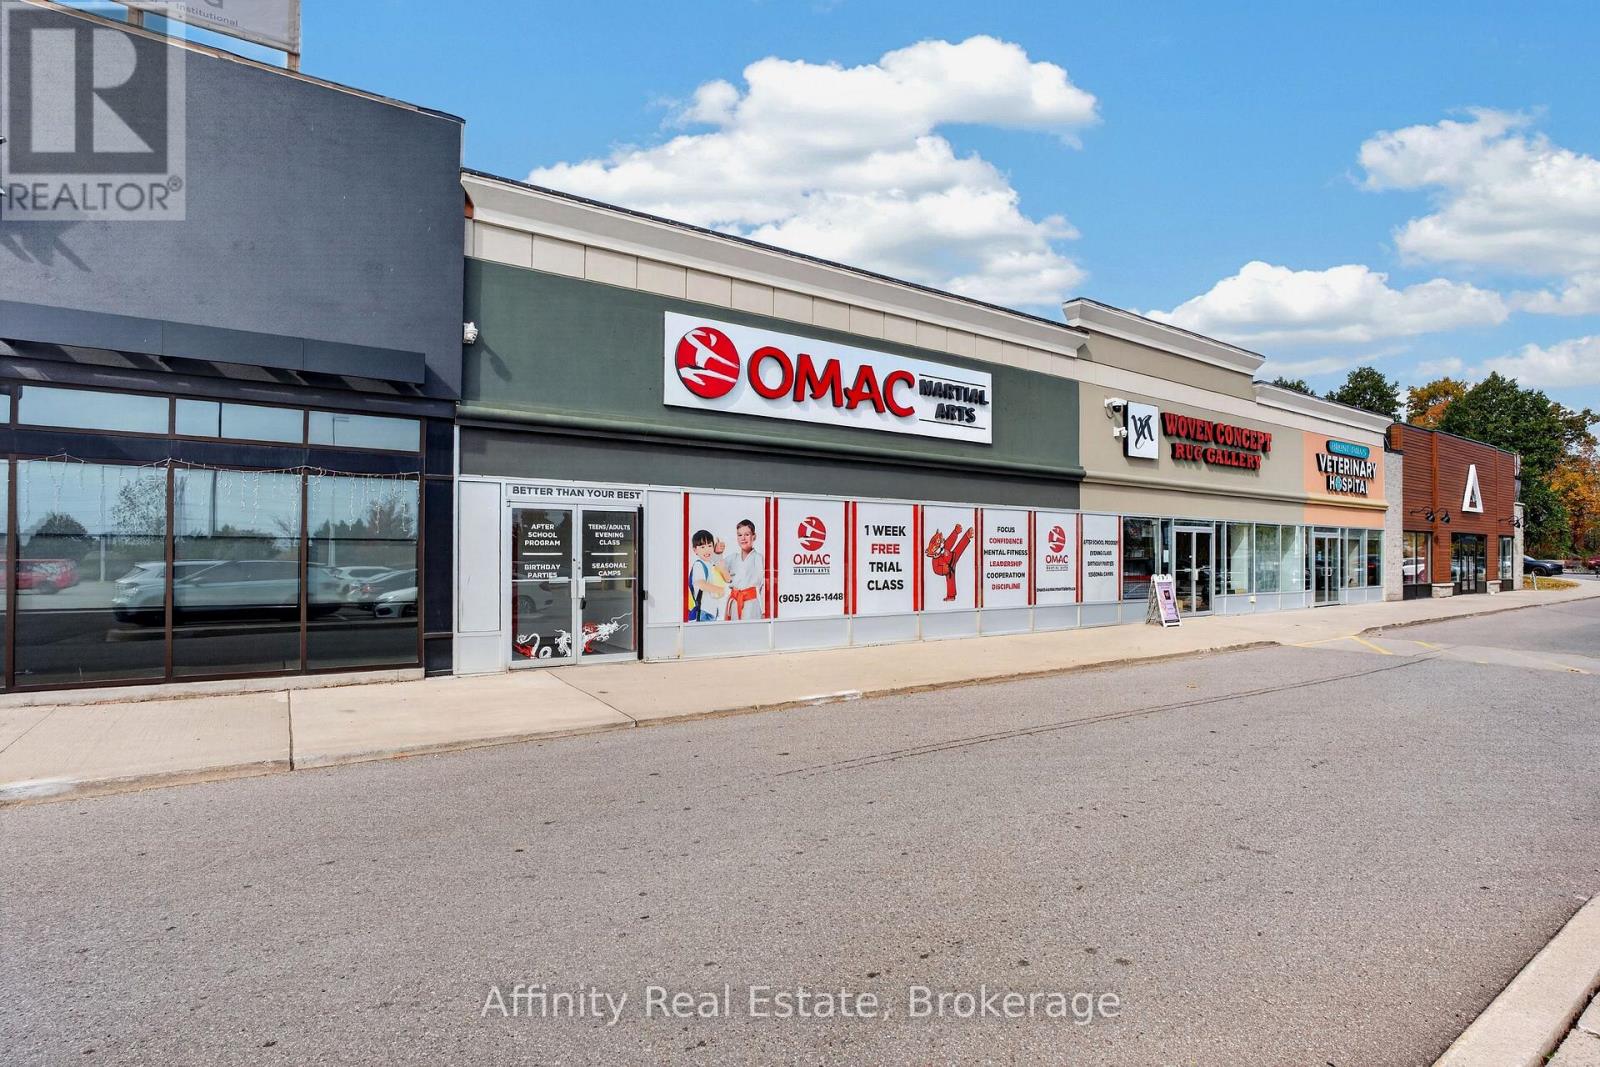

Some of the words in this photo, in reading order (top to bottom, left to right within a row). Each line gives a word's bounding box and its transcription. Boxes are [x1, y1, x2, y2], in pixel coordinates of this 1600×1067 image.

[176, 3, 239, 27] Institutional
[747, 345, 916, 418] OMAC
[919, 379, 989, 405] MARTIAL
[935, 403, 976, 423] ARTS
[1162, 412, 1214, 442] WOVEN
[1214, 423, 1272, 453] CONCEPT
[1172, 443, 1203, 462] RUG
[1204, 448, 1262, 470] GALLERY
[1317, 453, 1377, 479] VETERINARY
[512, 486, 553, 496] BETTER
[556, 488, 584, 497] THAN
[587, 489, 615, 499] YOUR
[617, 491, 641, 499] BEST
[1328, 475, 1369, 494] HOSPITAL
[864, 525, 870, 536] 1
[872, 525, 906, 536] WEEK
[871, 544, 900, 554] FREE
[793, 554, 831, 565] OMAC
[1046, 554, 1068, 564] OMAC
[869, 562, 902, 573] TRIAL
[867, 580, 904, 591] CLASS
[779, 593, 804, 604] (905)
[805, 592, 844, 602] 226-1448
